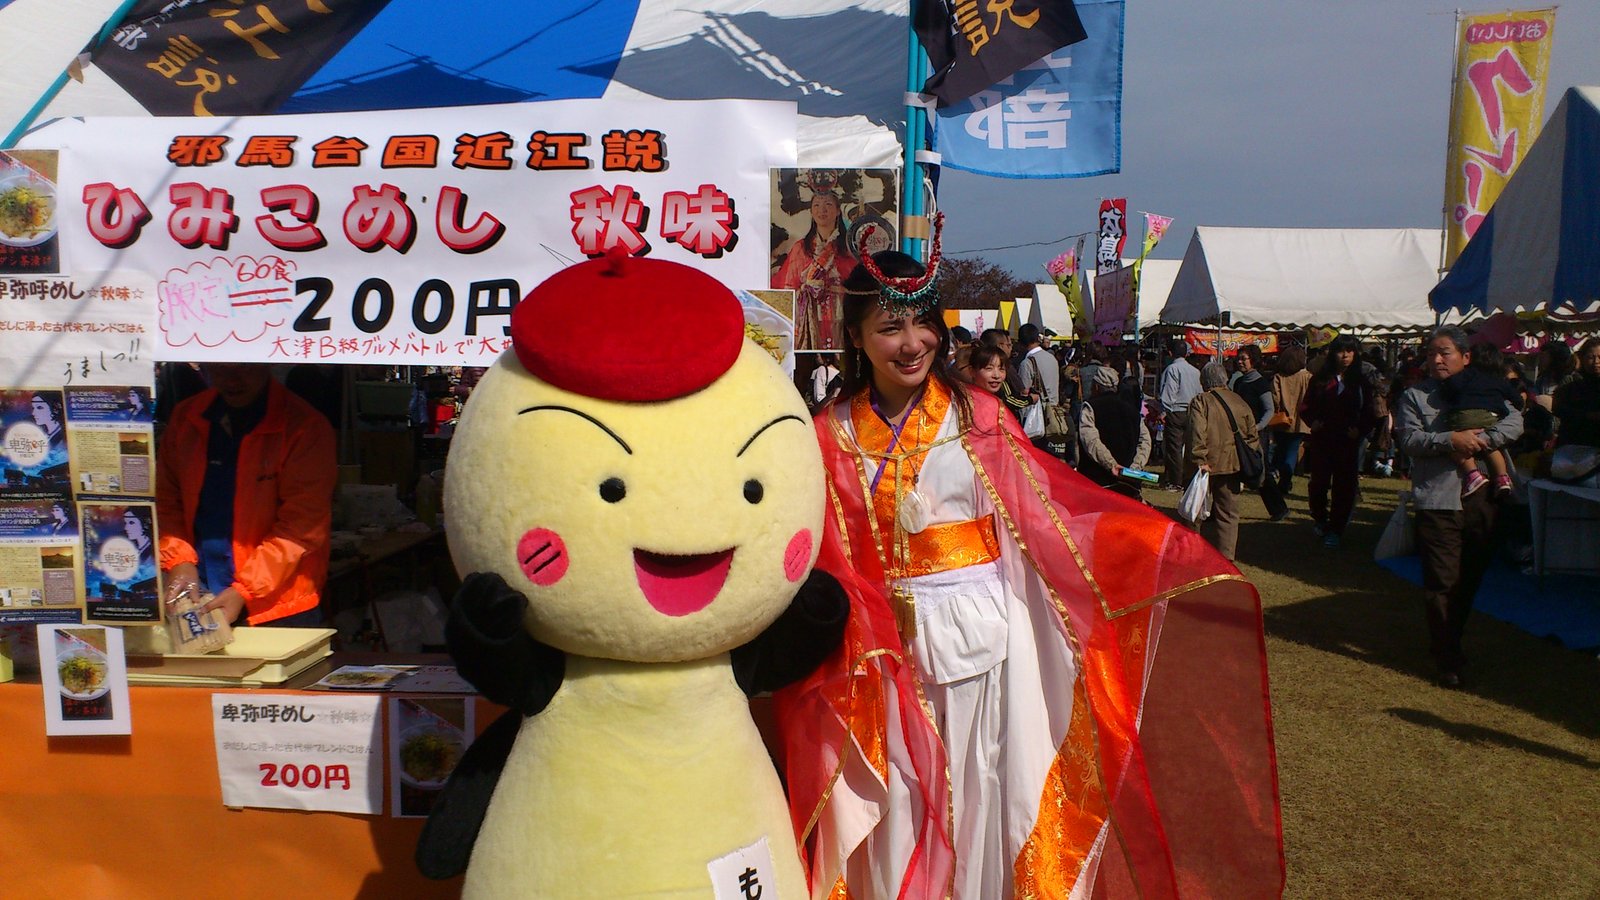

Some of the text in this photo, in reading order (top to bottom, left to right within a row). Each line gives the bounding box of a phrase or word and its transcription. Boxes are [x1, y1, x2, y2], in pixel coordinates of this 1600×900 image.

[167, 129, 669, 172] 邪馬台国近江説
[82, 182, 506, 254] ひみこめし
[570, 184, 739, 259] 秋味
[293, 277, 521, 337] 200円
[259, 763, 351, 790] 200円
